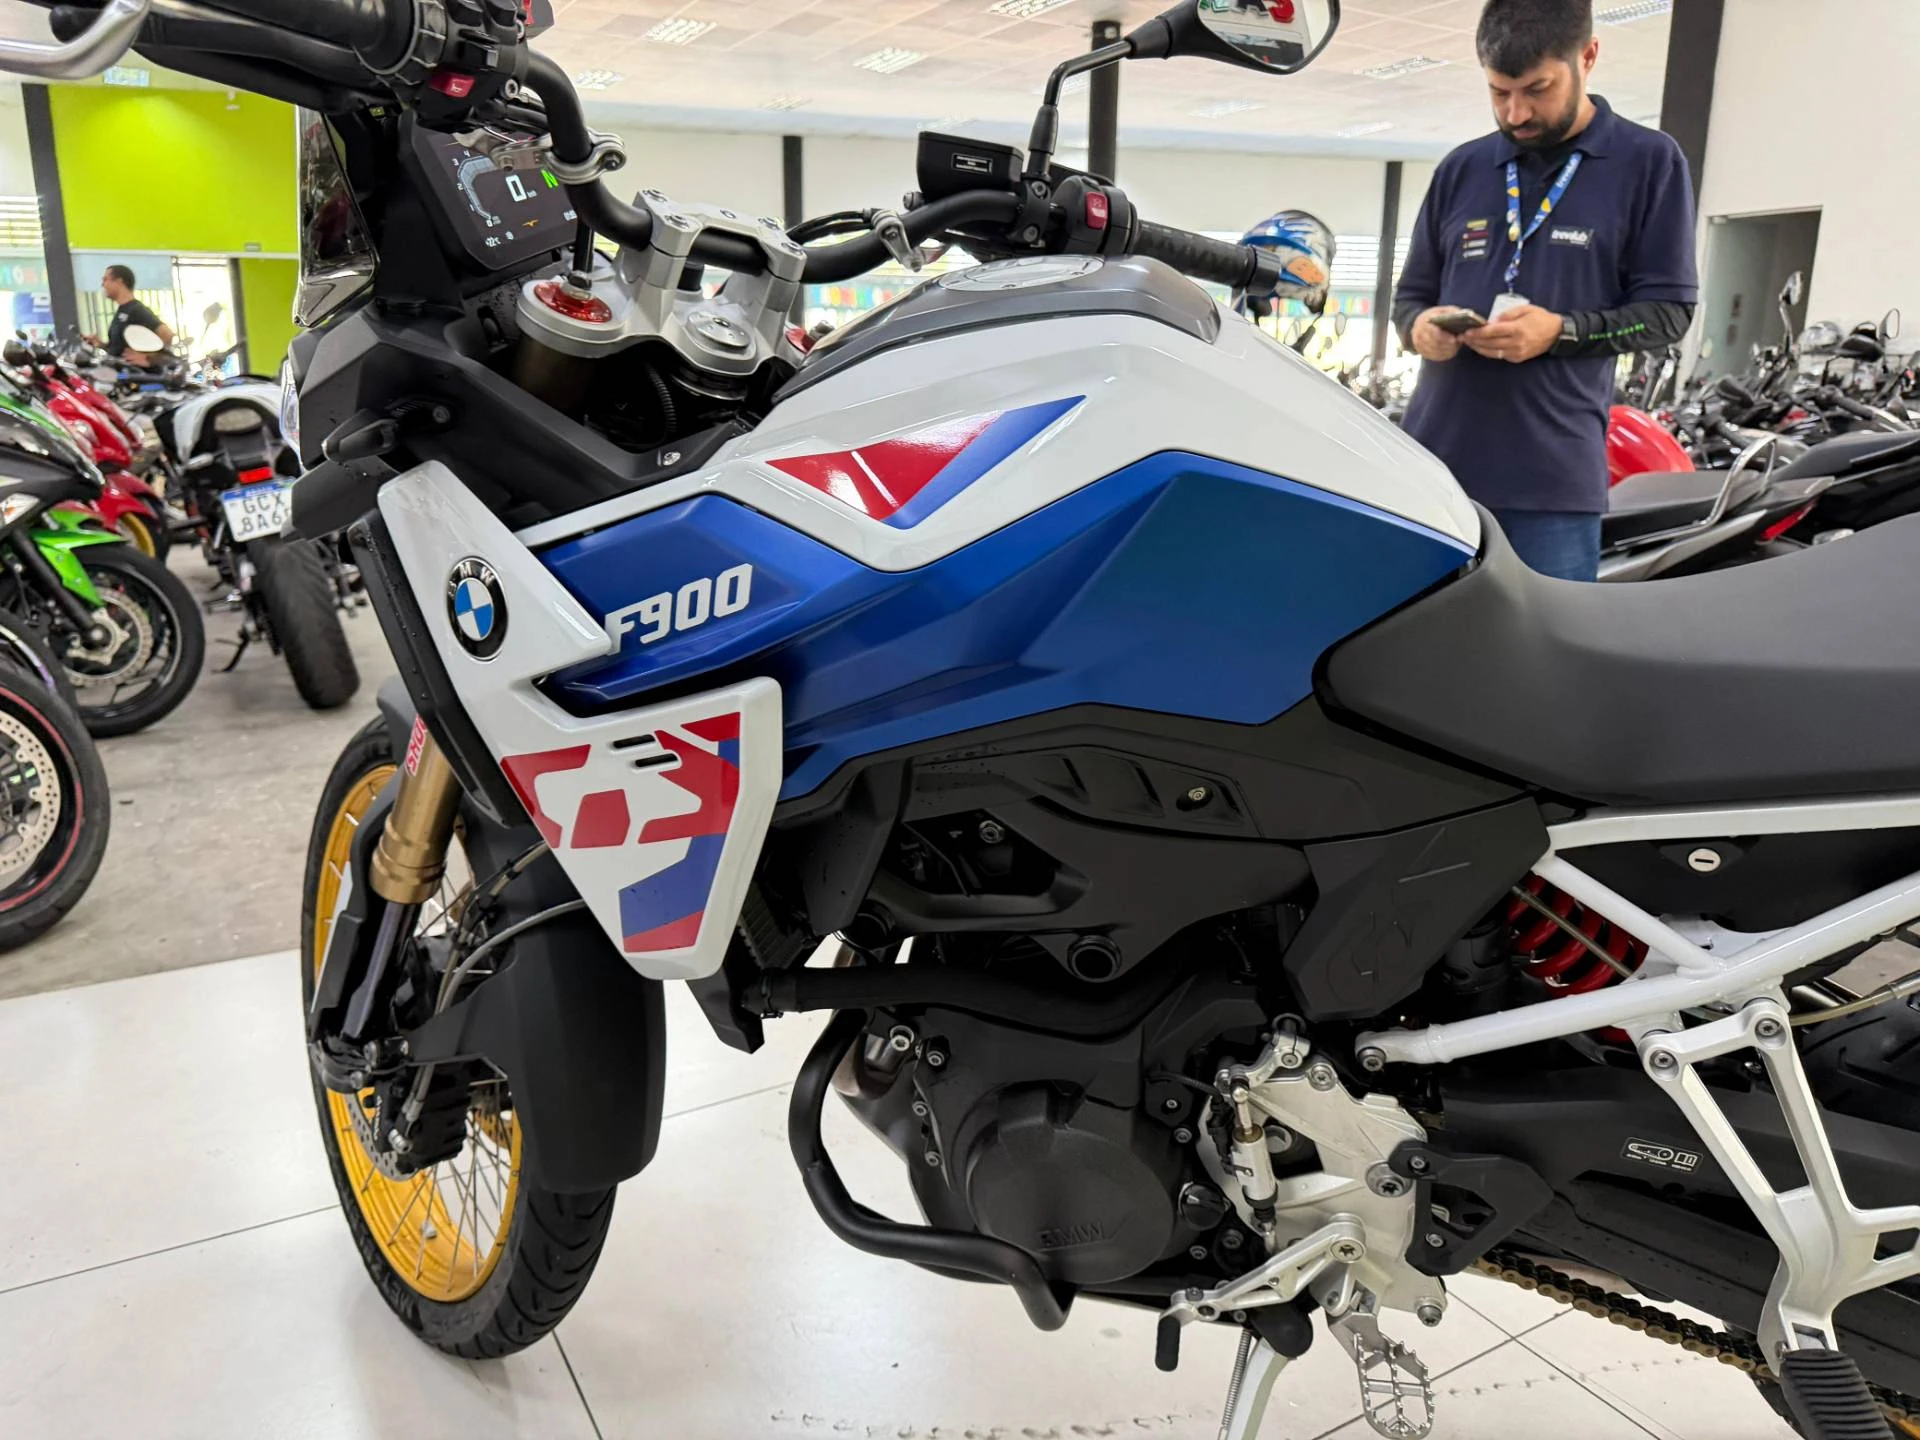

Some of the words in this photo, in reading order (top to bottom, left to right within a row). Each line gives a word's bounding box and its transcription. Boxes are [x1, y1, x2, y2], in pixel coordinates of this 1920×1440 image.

[505, 174, 528, 202] 0
[242, 491, 285, 514] GCX
[448, 561, 496, 599] BMW
[604, 563, 753, 656] F900
